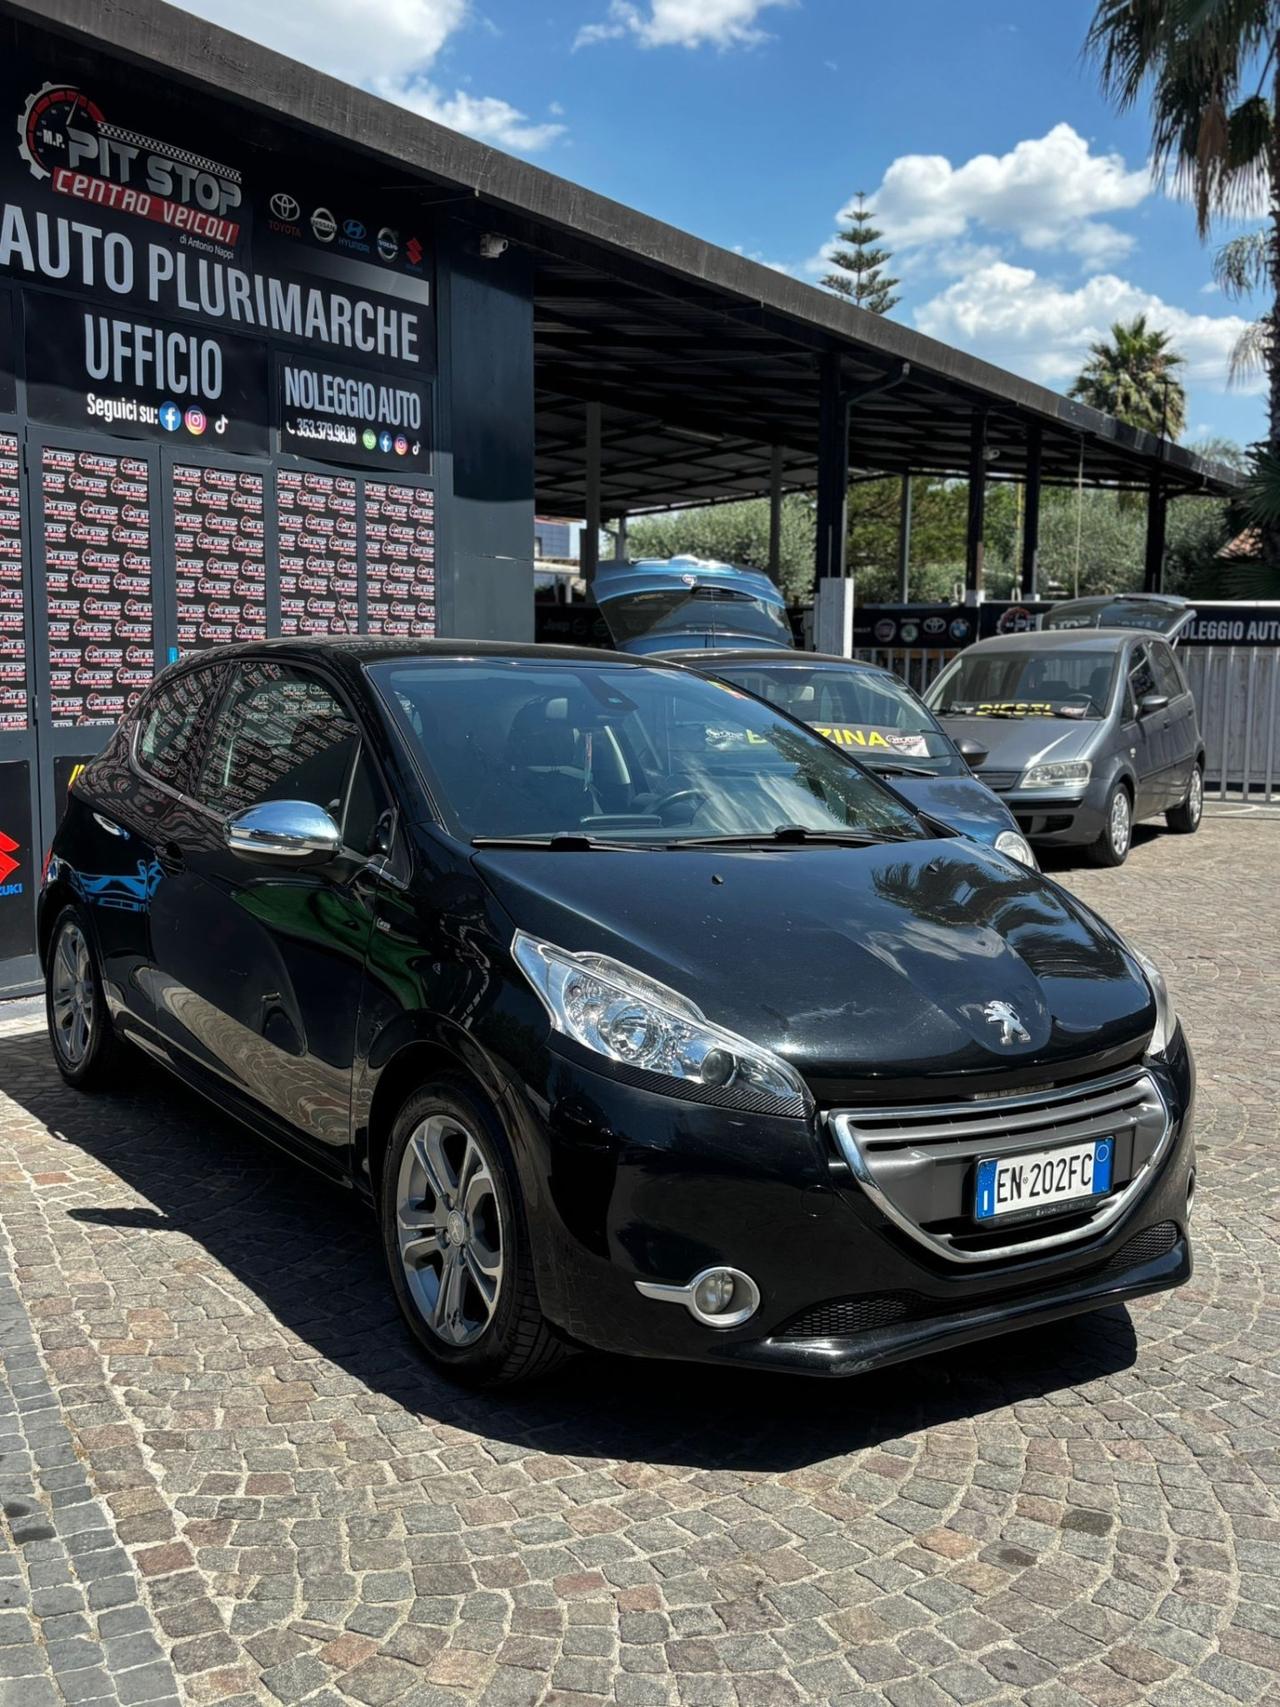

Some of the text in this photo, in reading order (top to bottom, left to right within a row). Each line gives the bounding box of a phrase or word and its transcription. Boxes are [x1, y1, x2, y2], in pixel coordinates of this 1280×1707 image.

[42, 129, 65, 149] M.P.
[66, 127, 242, 216] PIT STOP
[268, 220, 302, 238] TOYOTA
[312, 219, 336, 232] NISSAN
[179, 233, 187, 245] di
[188, 236, 214, 254] Antonio
[0, 203, 419, 363] AUTO PLURIMARCHE
[84, 313, 223, 400] UFFICIO
[87, 392, 159, 424] Seguici su:
[284, 366, 421, 430] NOLEGGIO AUTO
[1179, 620, 1244, 640] OLEGGIO
[1247, 620, 1280, 640] AUT
[0, 883, 23, 896] ZUKI
[1029, 1153, 1093, 1198] 202FC
